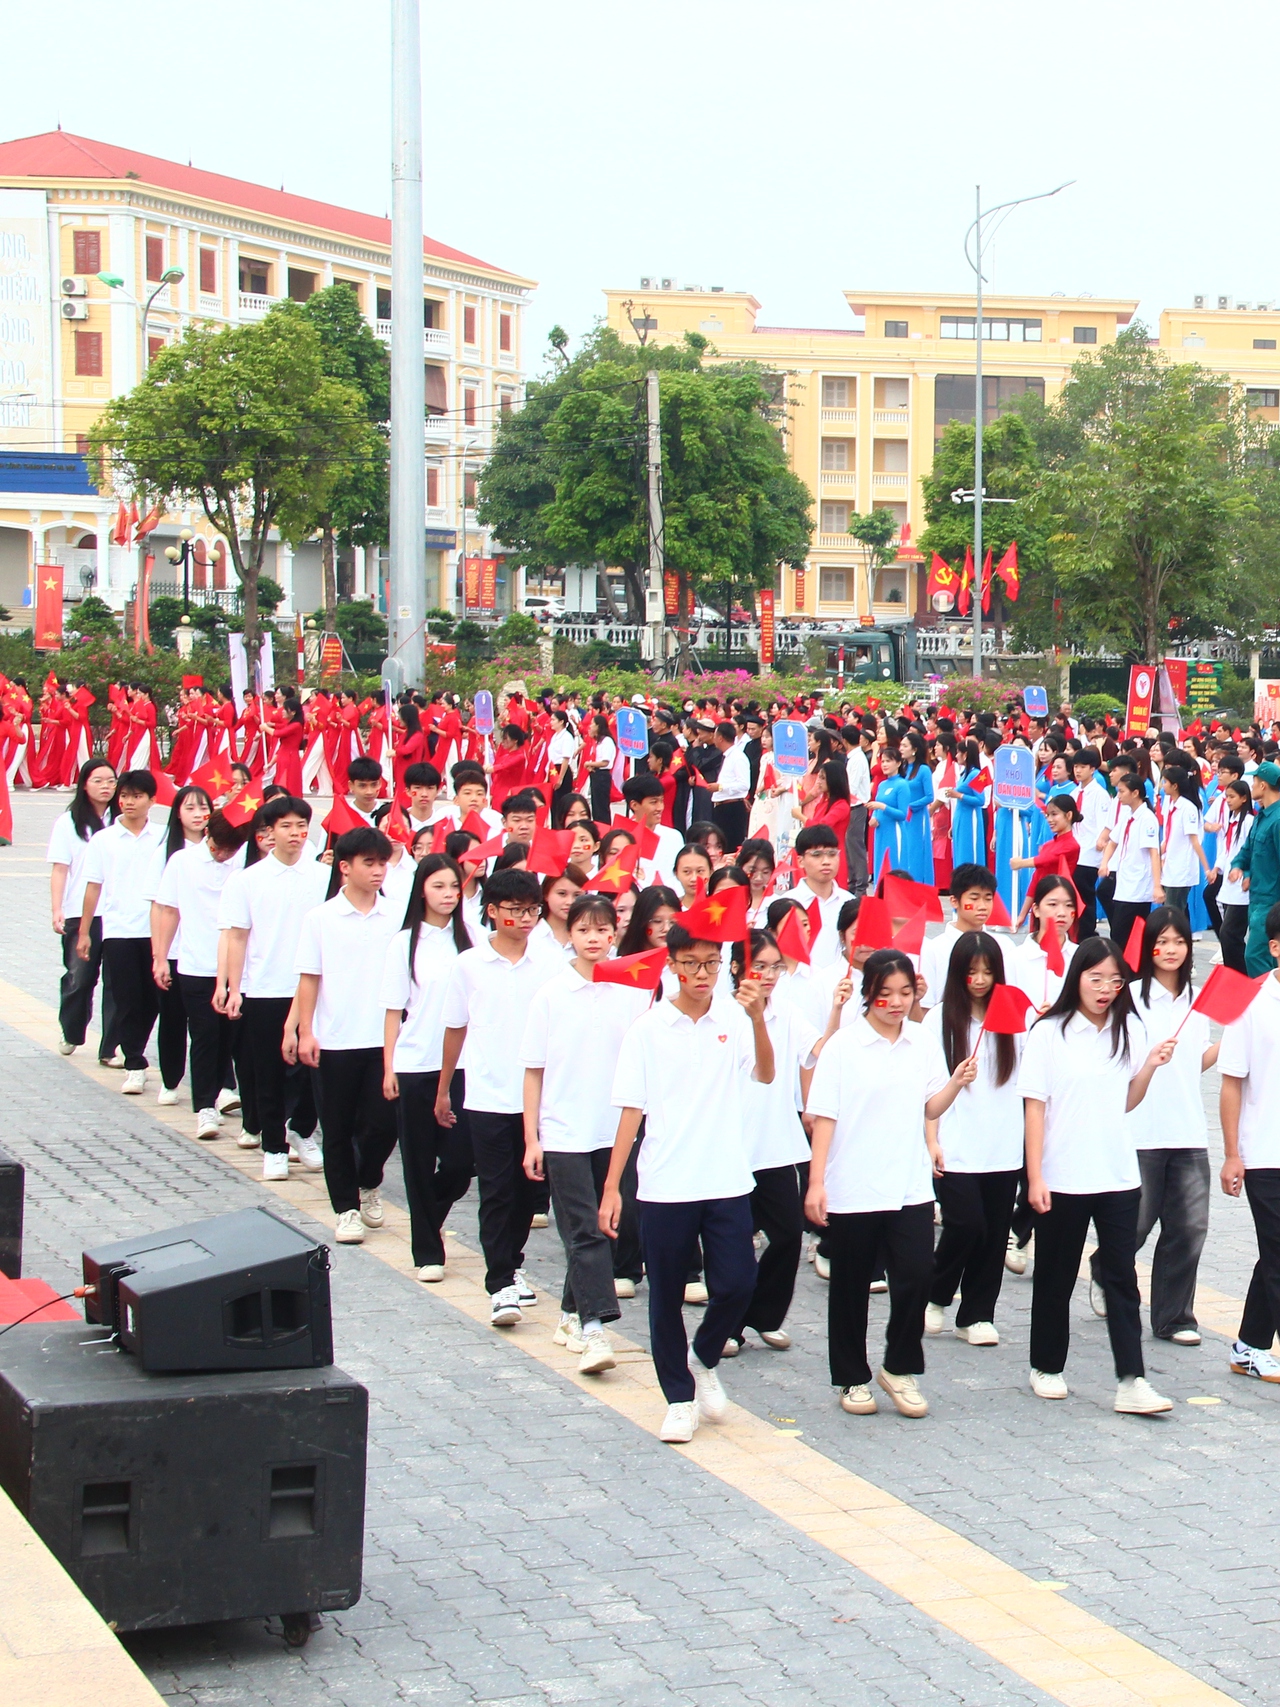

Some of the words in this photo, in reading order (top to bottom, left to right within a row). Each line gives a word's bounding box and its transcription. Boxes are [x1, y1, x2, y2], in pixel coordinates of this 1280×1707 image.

[1005, 766, 1023, 780] KHỐI
[997, 781, 1011, 795] DÂN
[1012, 784, 1032, 798] QUÂN
